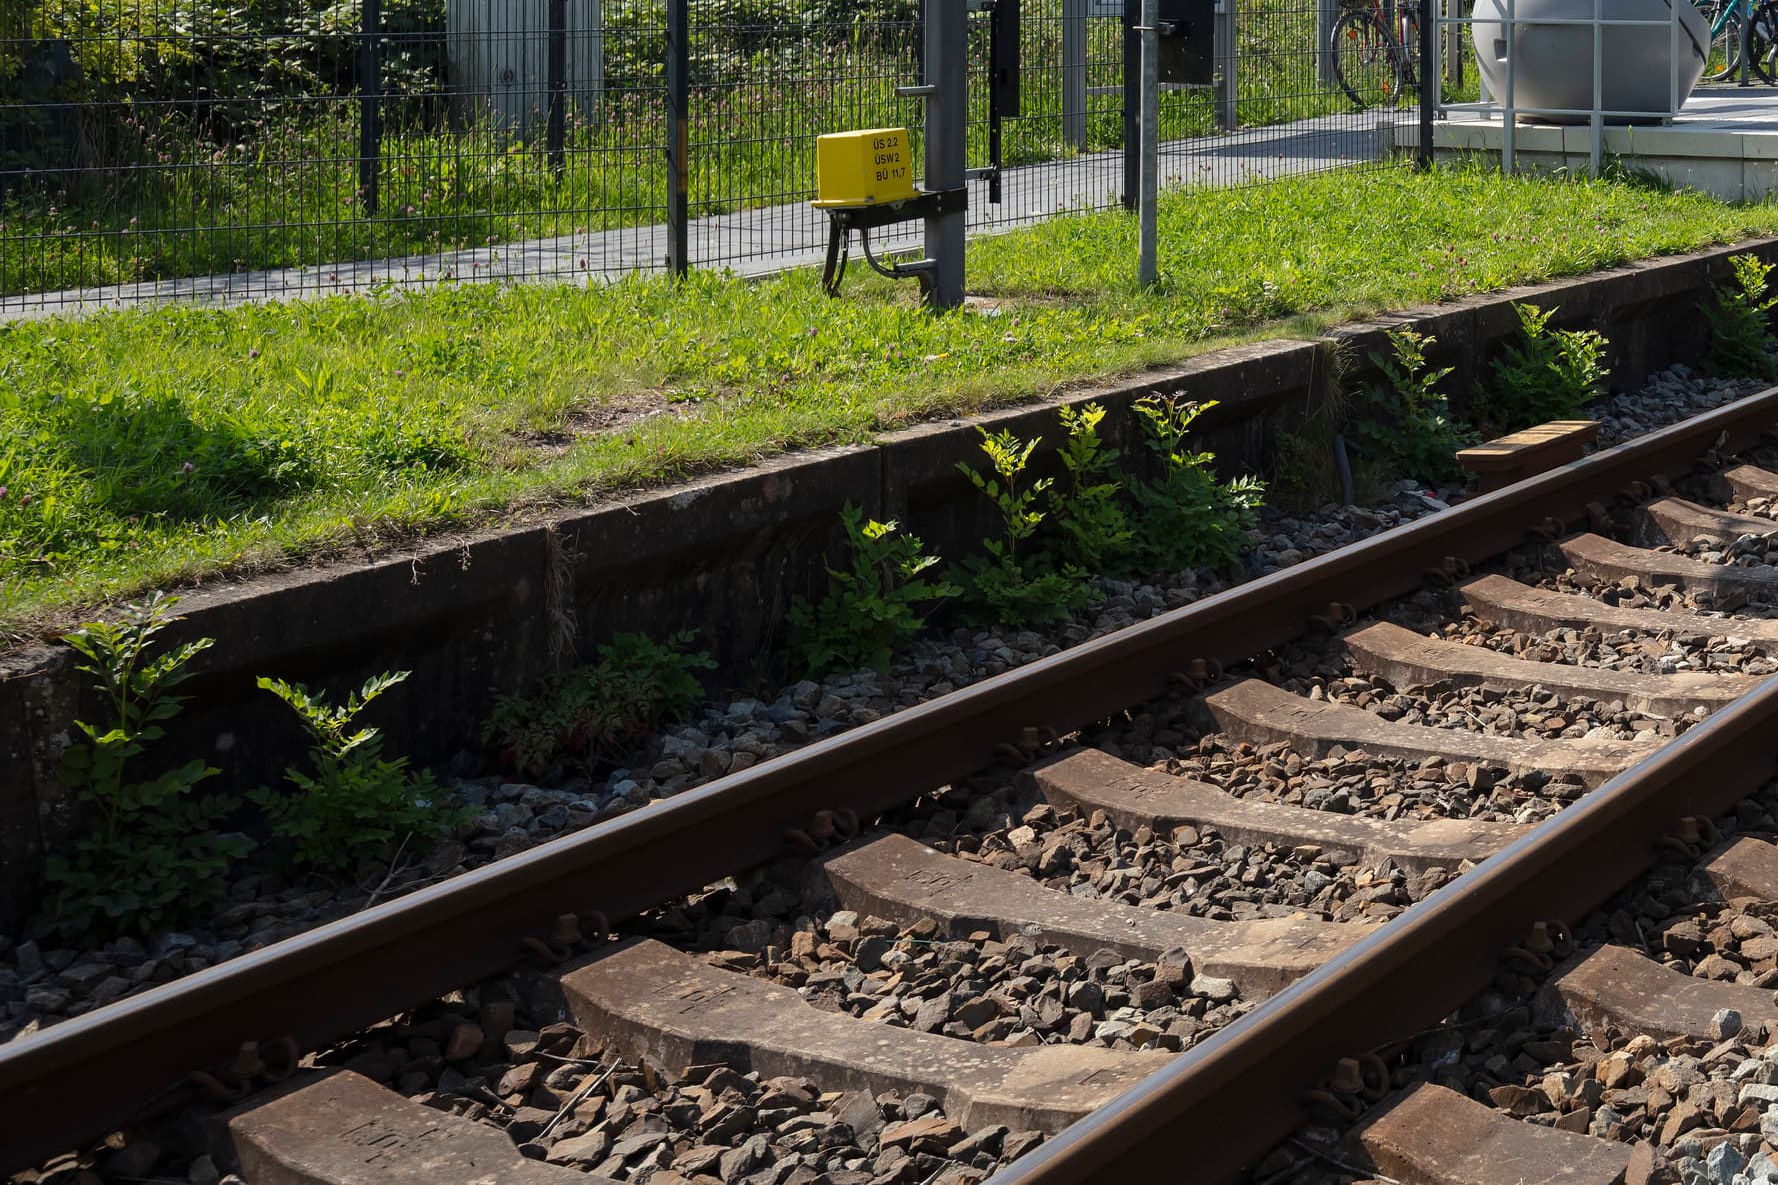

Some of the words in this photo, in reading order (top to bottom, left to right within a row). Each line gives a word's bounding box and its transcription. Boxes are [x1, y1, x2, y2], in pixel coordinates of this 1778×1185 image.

[873, 137, 885, 150] ÜS
[876, 167, 889, 181] BÜ
[892, 167, 906, 179] 11,7
